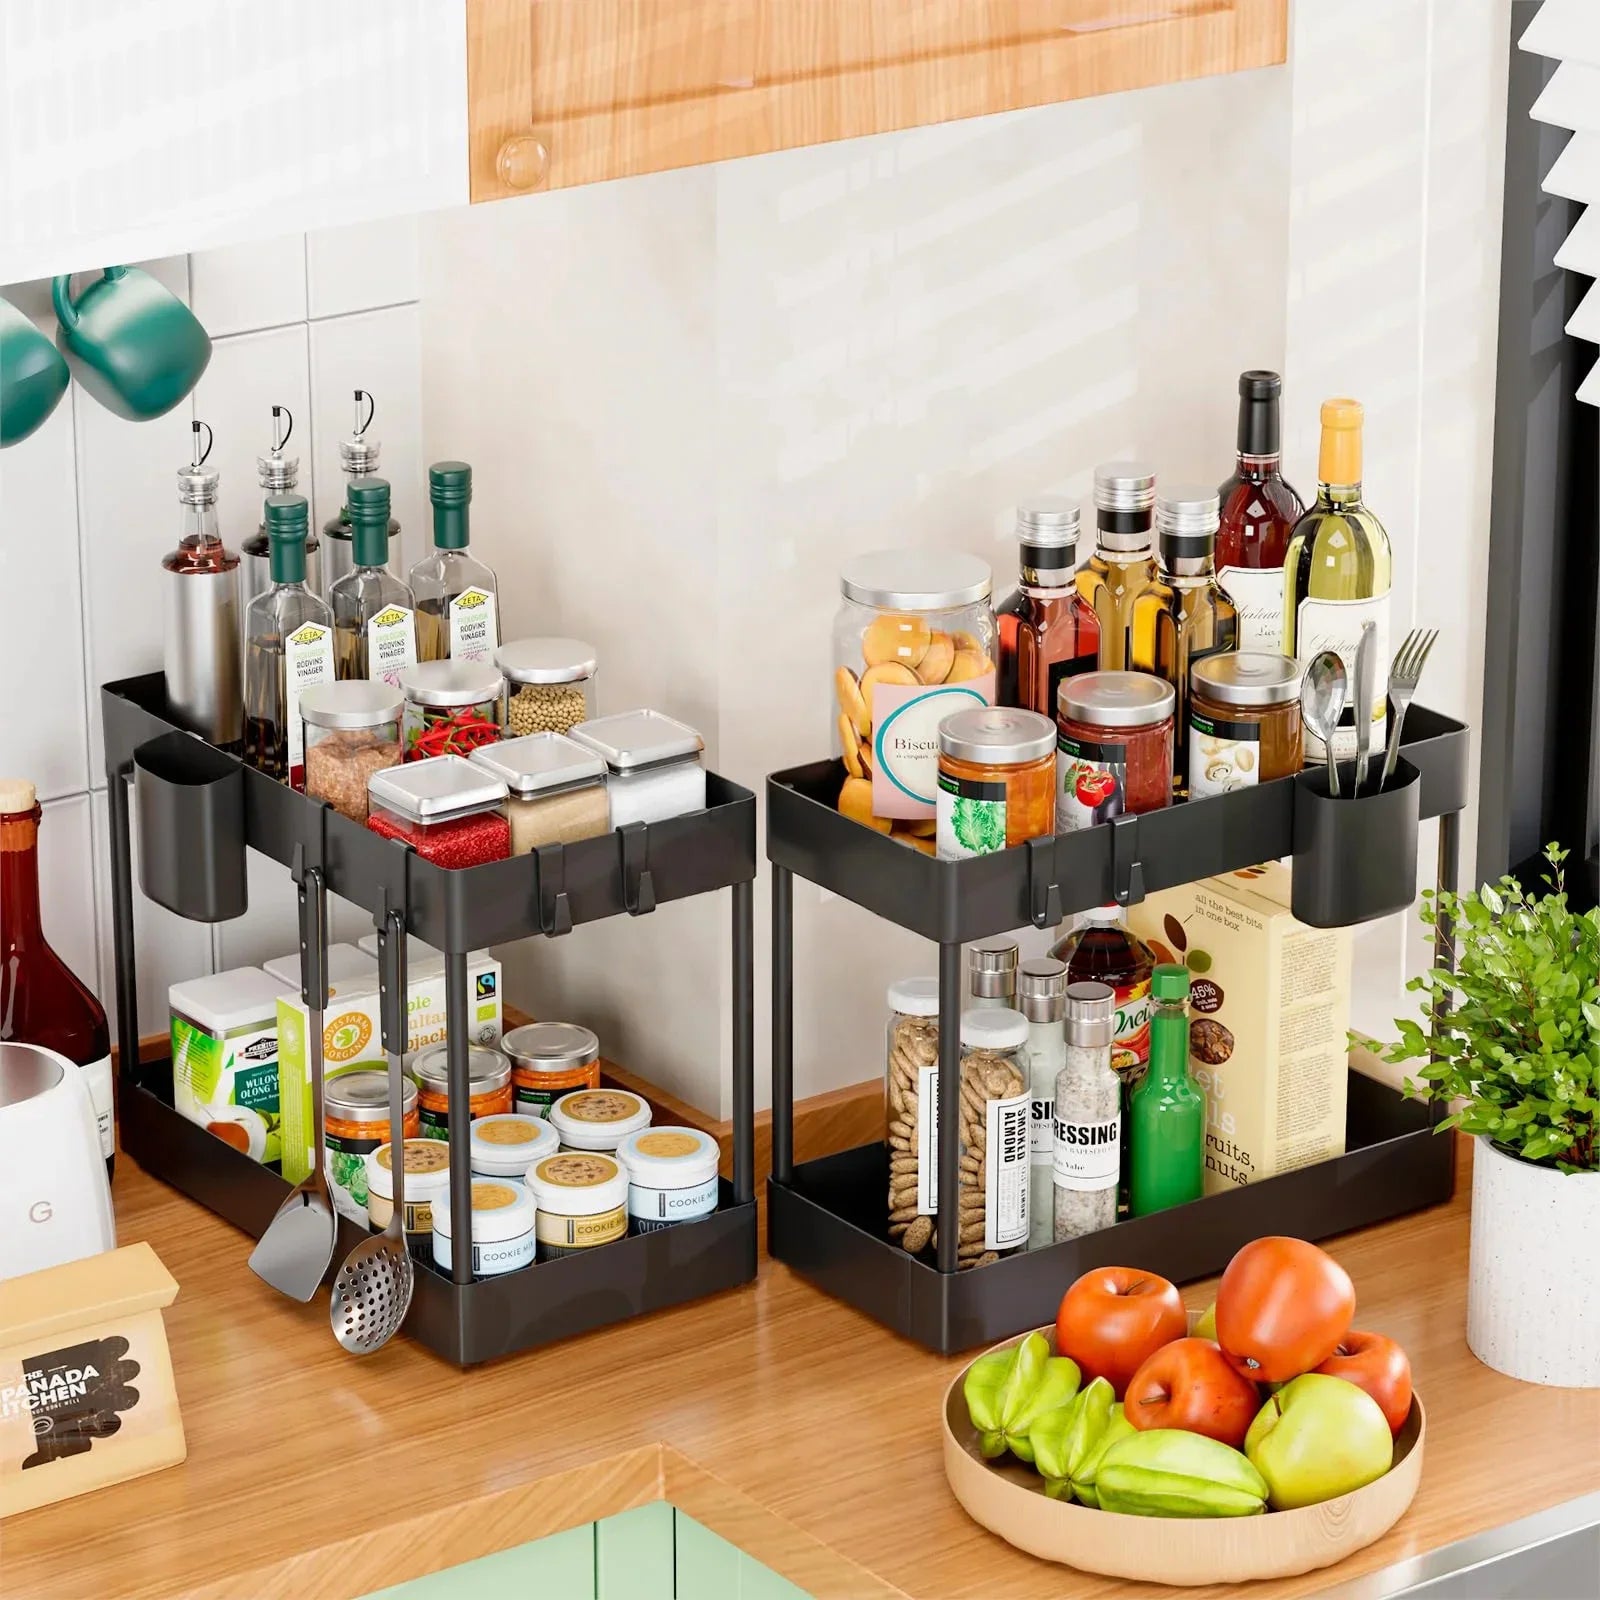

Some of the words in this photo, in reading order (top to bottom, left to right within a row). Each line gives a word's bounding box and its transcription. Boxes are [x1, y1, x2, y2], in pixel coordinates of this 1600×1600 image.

[462, 595, 482, 605] ZETA
[381, 613, 401, 623] ZETA
[298, 631, 318, 641] ZETA
[460, 630, 486, 641] VINAGER
[379, 647, 405, 659] VINAGER
[296, 665, 323, 678] VINAGER
[1195, 894, 1207, 905] all
[1208, 899, 1224, 912] the
[1225, 906, 1245, 922] best
[1246, 915, 1263, 930] bits
[1195, 904, 1204, 916] in
[1206, 911, 1223, 924] one
[1224, 917, 1240, 932] box
[1191, 983, 1217, 999] 45%
[328, 1033, 369, 1060] ORGANIC
[240, 1084, 271, 1099] OLONG
[1004, 1111, 1017, 1163] ALMOND
[1017, 1107, 1027, 1161] SMOKED
[668, 1192, 706, 1209] COOKIE
[29, 1200, 53, 1224] G
[577, 1218, 615, 1235] COOKIE
[483, 1247, 521, 1262] COOKIE
[24, 1369, 44, 1381] THE
[0, 1381, 87, 1418] ITCHEN
